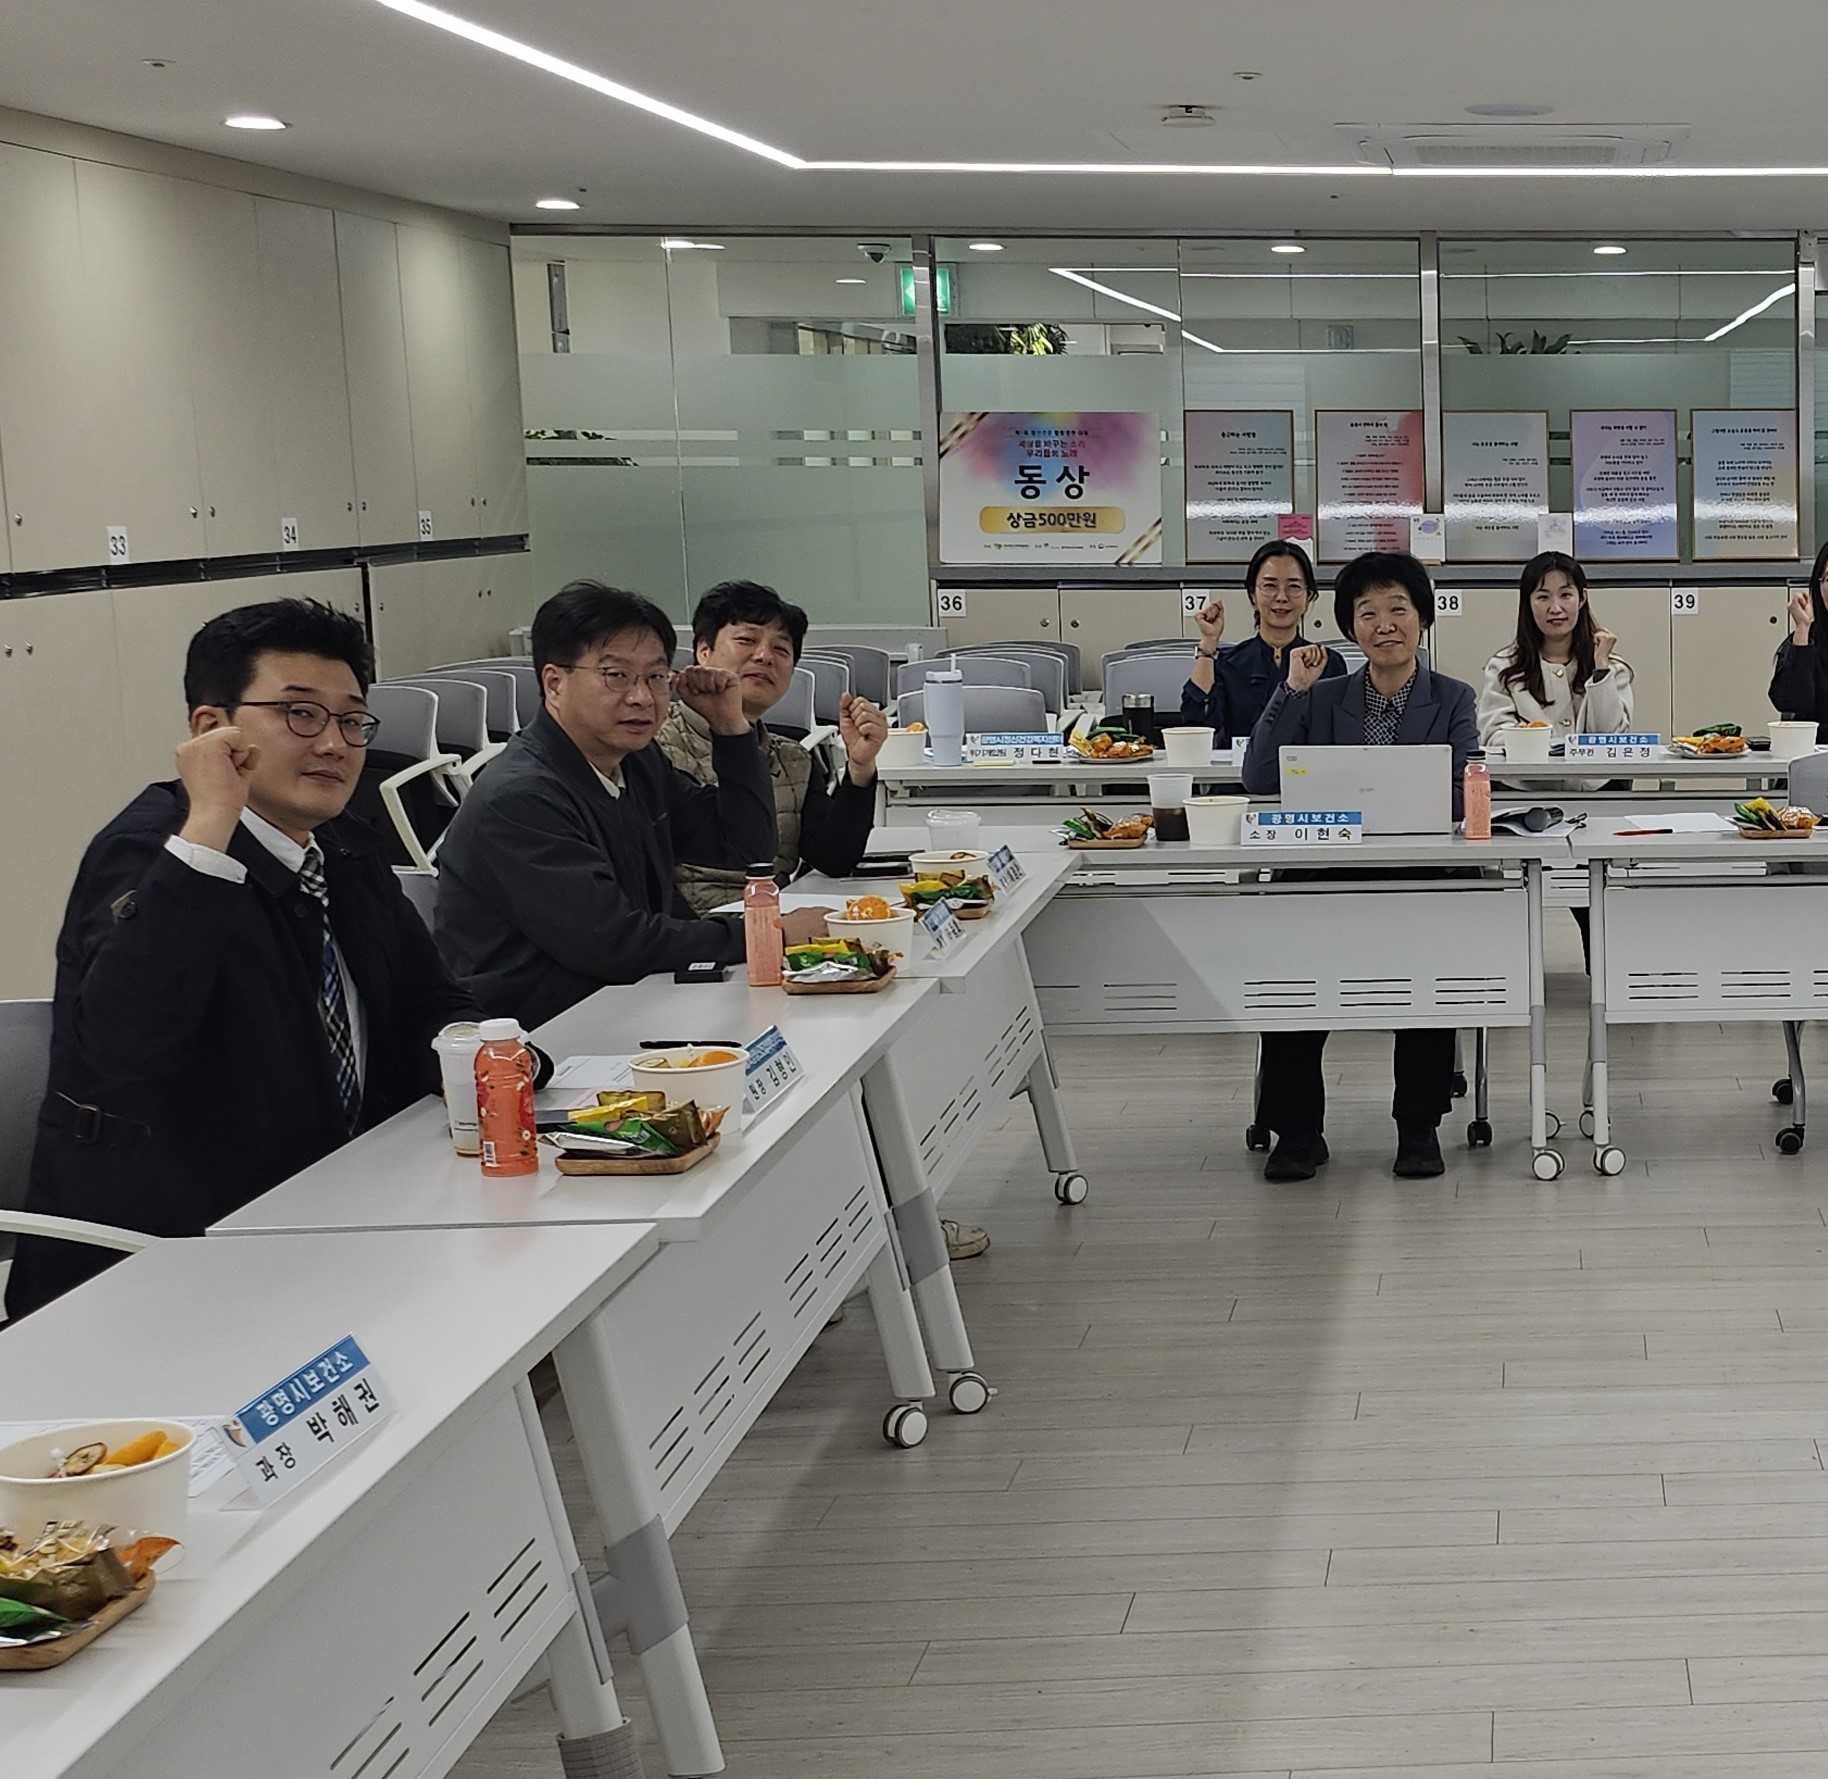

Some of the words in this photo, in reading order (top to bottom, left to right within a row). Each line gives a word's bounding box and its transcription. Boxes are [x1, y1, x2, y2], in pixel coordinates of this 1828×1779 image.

[1006, 512, 1097, 529] 상금500만원
[283, 525, 297, 544] 34
[109, 535, 127, 556] 33
[940, 595, 963, 611] 36
[1184, 595, 1206, 612] 37
[1437, 595, 1459, 611] 38
[1674, 594, 1696, 610] 39
[1271, 813, 1350, 824] 광명시보건소
[255, 1351, 354, 1427] 광명시보건소
